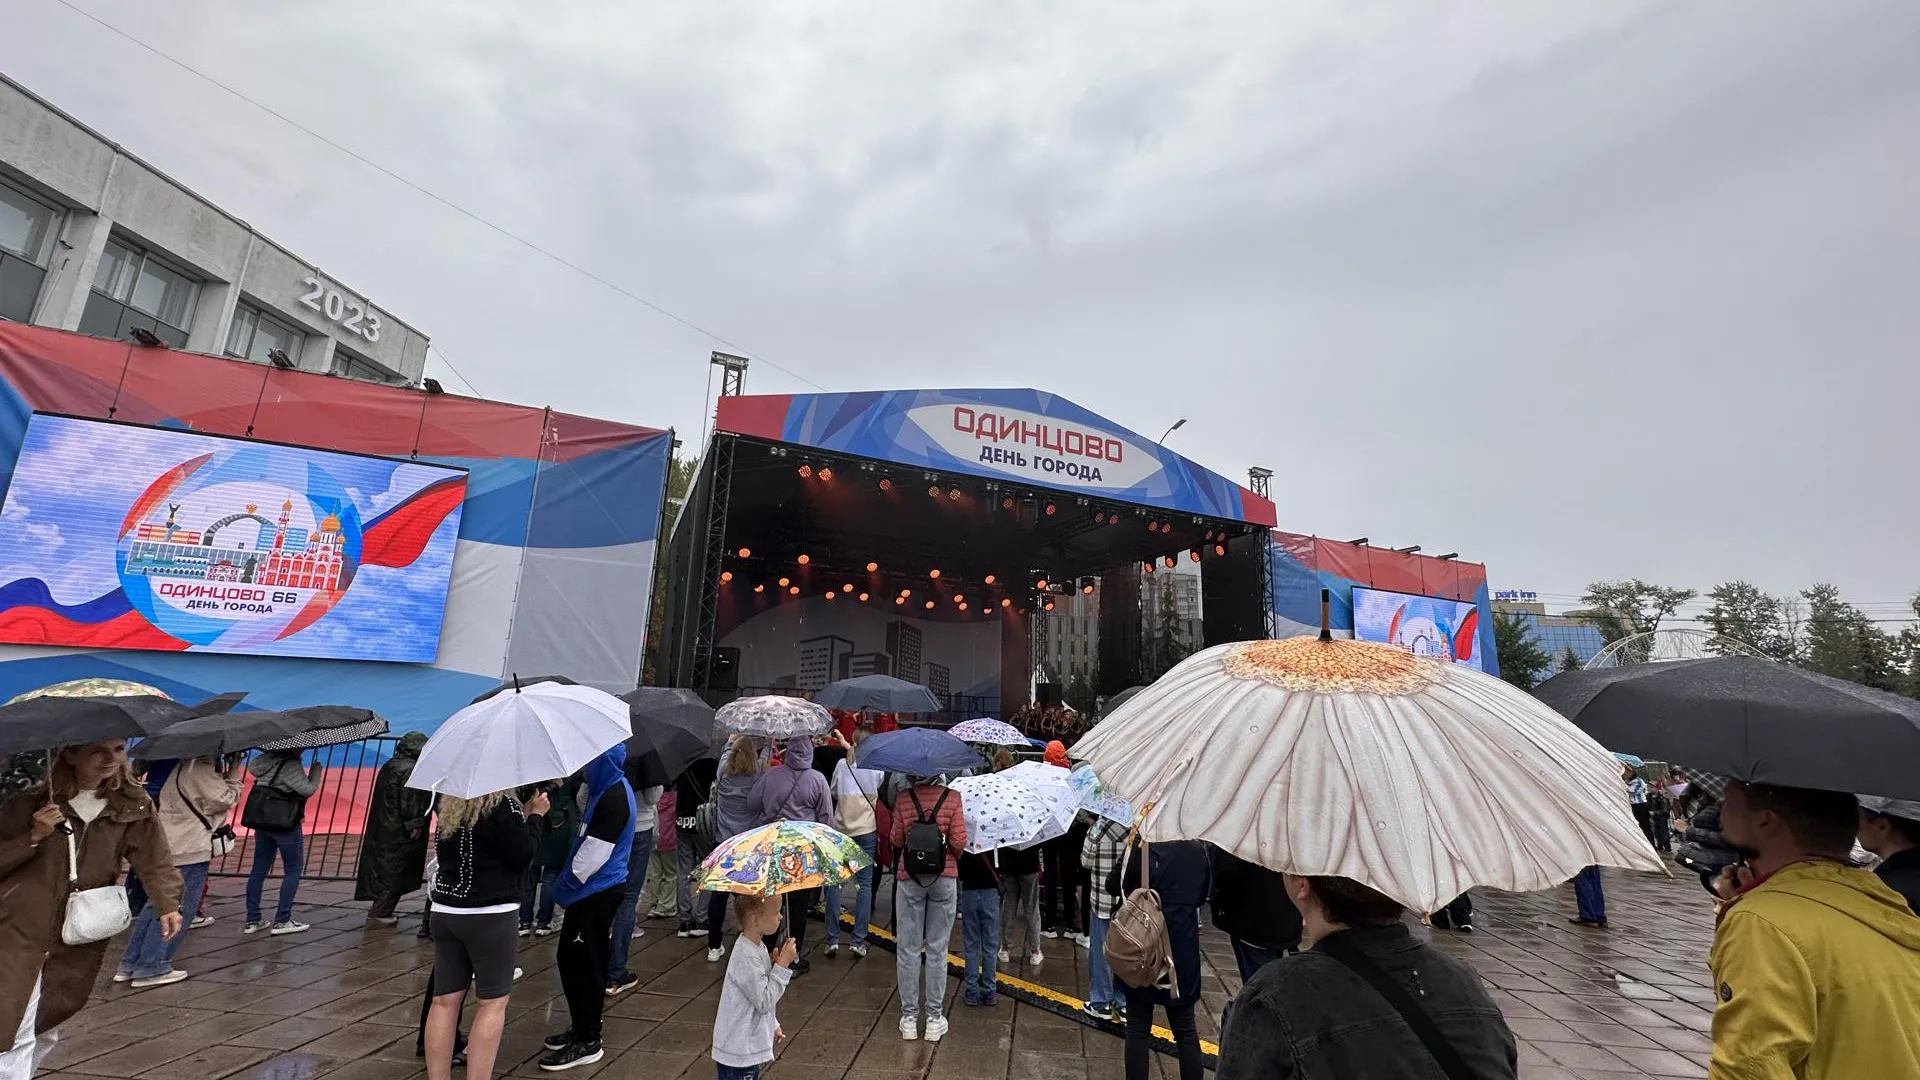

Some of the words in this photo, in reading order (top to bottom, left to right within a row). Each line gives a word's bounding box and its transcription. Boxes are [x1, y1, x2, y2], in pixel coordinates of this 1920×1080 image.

[299, 277, 381, 342] 2023
[954, 407, 1122, 463] ОДИНЦОВО
[979, 446, 1027, 466] ДЕНЬ
[1034, 456, 1102, 481] ГОРОДА
[160, 584, 265, 601] ОДИНЦОВО
[272, 592, 297, 603] 66
[186, 600, 219, 610] ДЕНЬ
[224, 602, 272, 613] ГОРОДА
[676, 816, 696, 828] app
